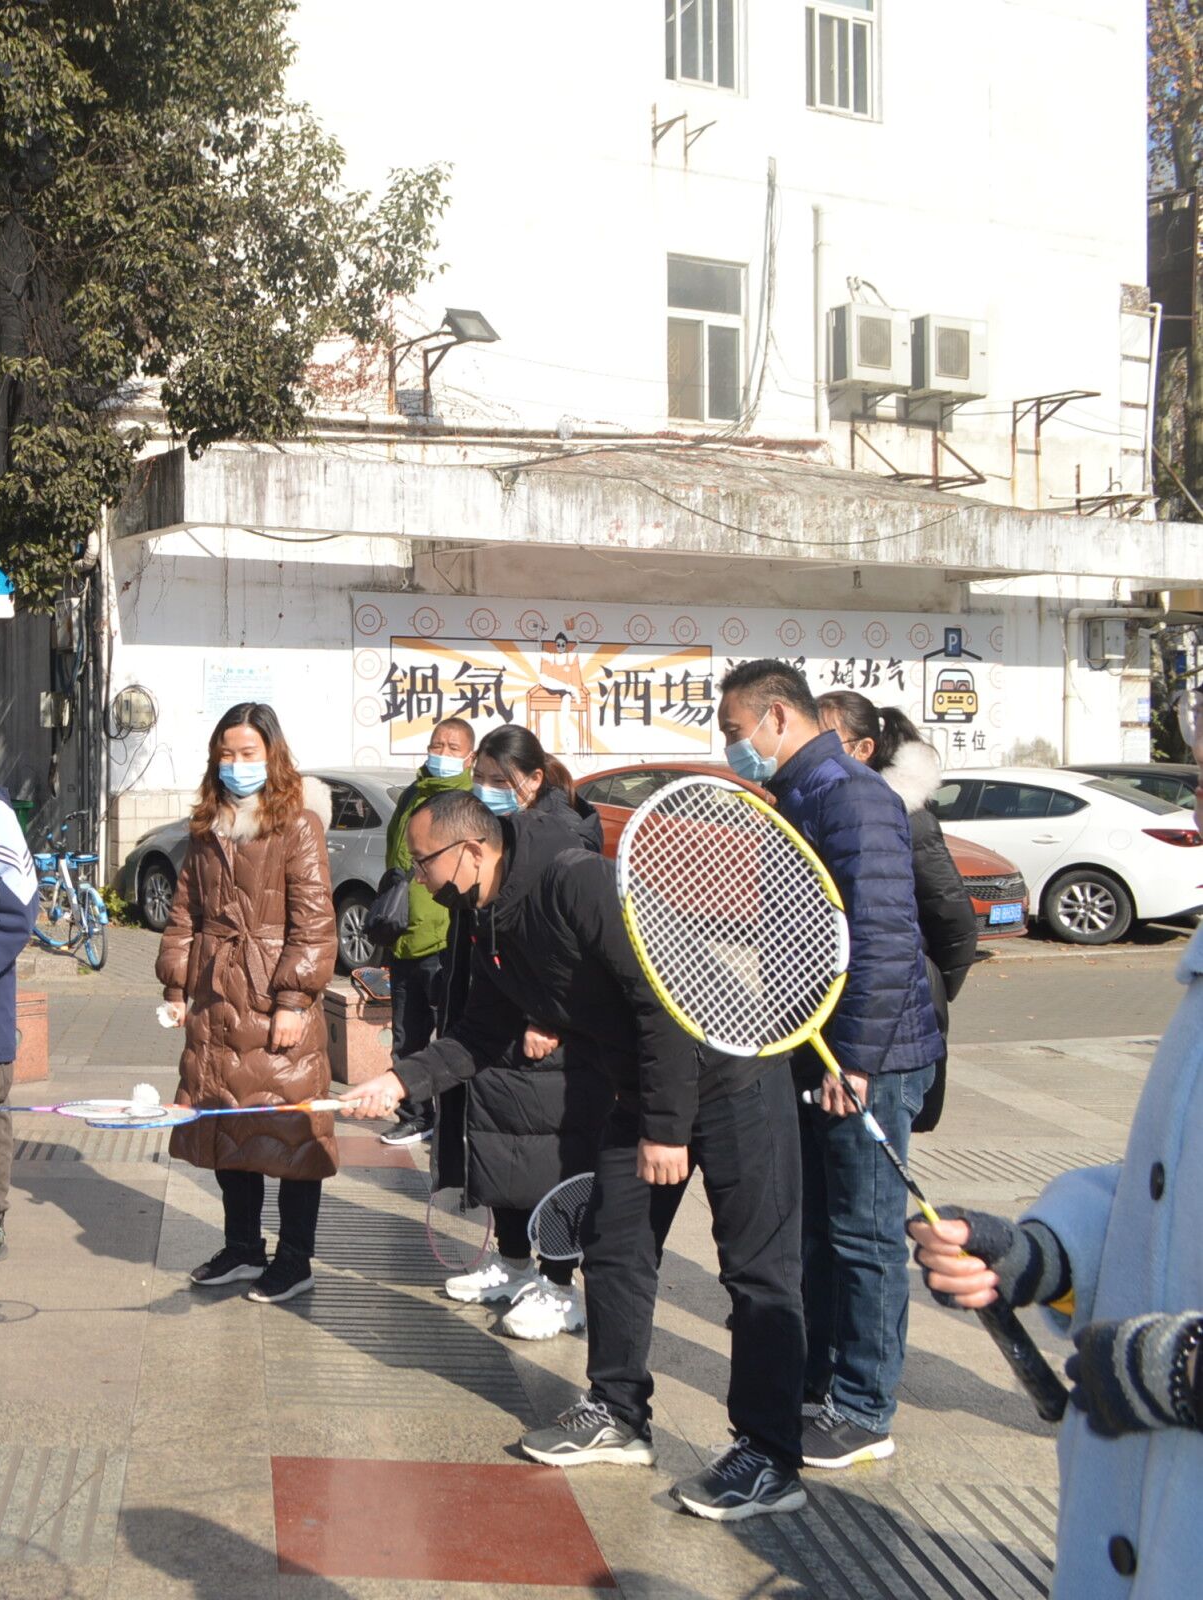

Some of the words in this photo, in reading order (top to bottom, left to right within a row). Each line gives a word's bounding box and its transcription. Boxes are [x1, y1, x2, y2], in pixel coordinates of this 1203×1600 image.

[949, 633, 958, 651] P
[380, 661, 515, 725] 鍋氣
[952, 730, 986, 751] 车位
